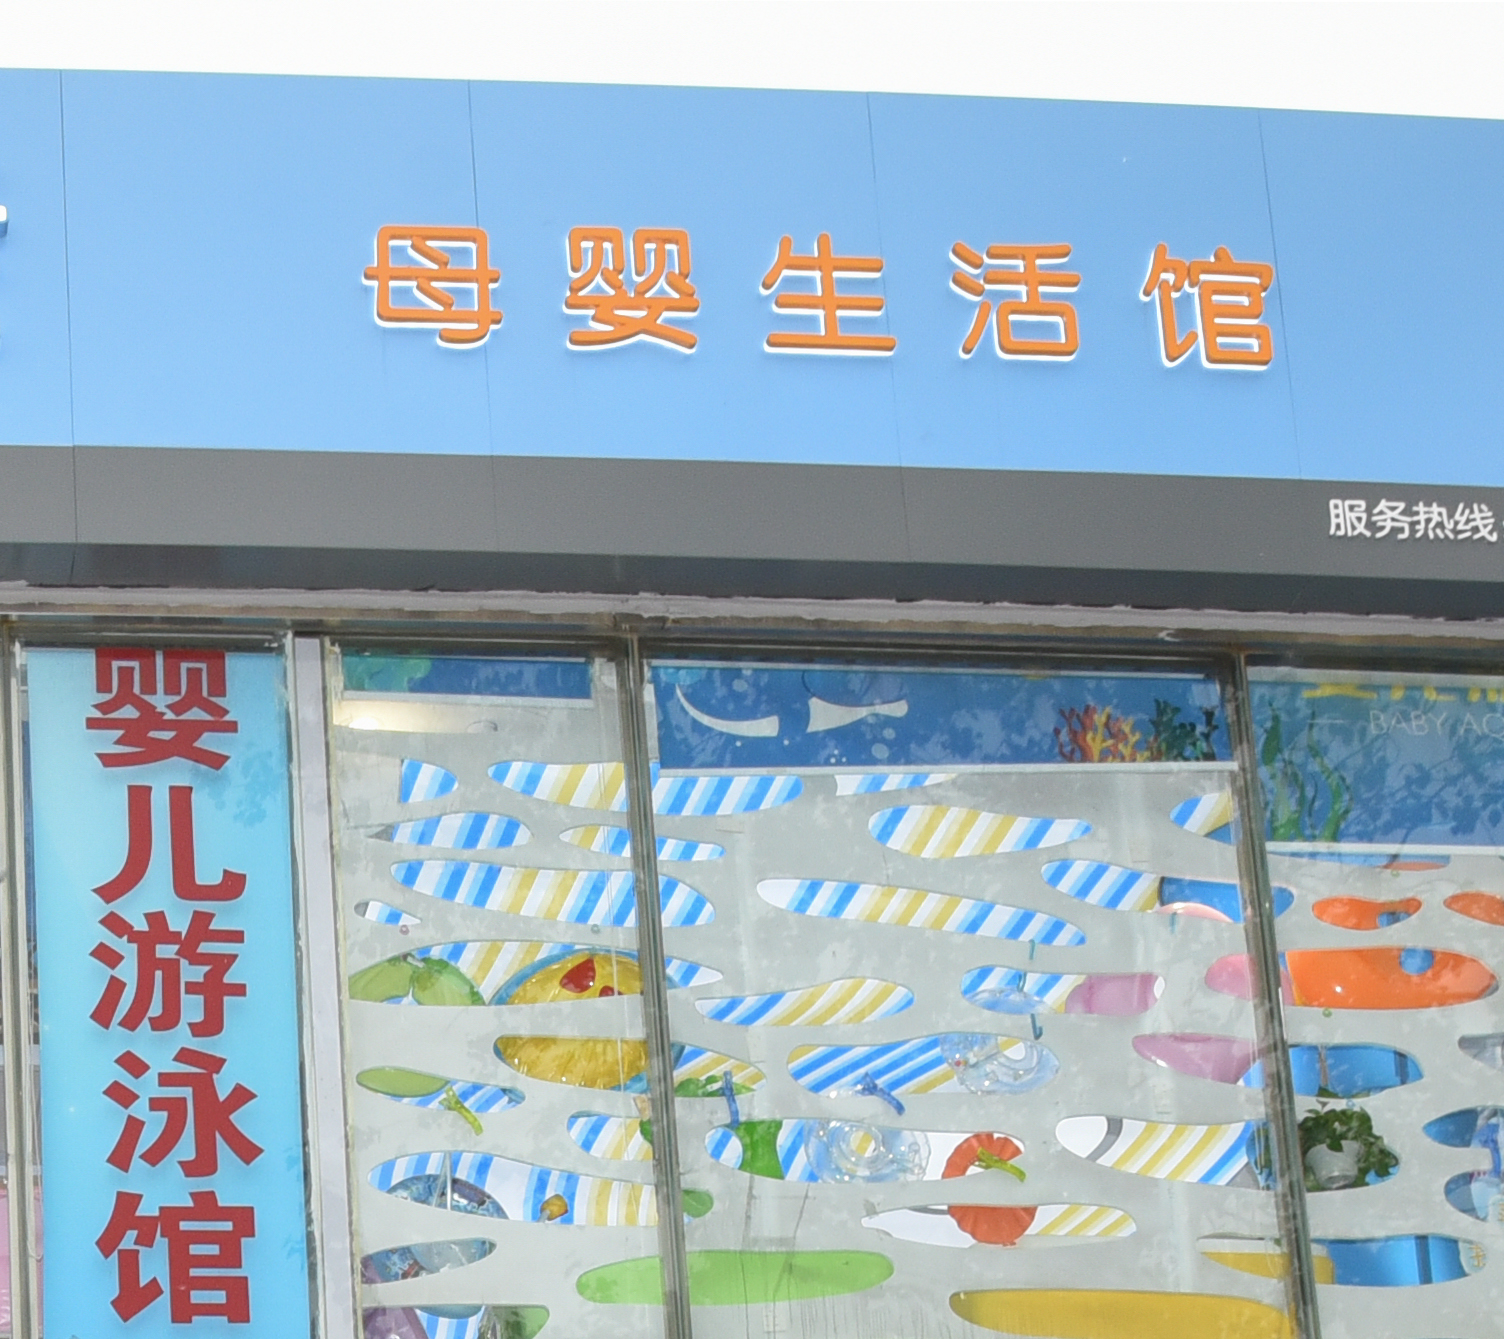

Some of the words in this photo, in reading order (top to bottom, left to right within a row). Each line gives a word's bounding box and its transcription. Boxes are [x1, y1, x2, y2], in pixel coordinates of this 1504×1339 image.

[362, 222, 1276, 370] 母婴生活馆
[1368, 711, 1448, 737] BABY
[87, 648, 264, 1326] 婴儿游泳馆
